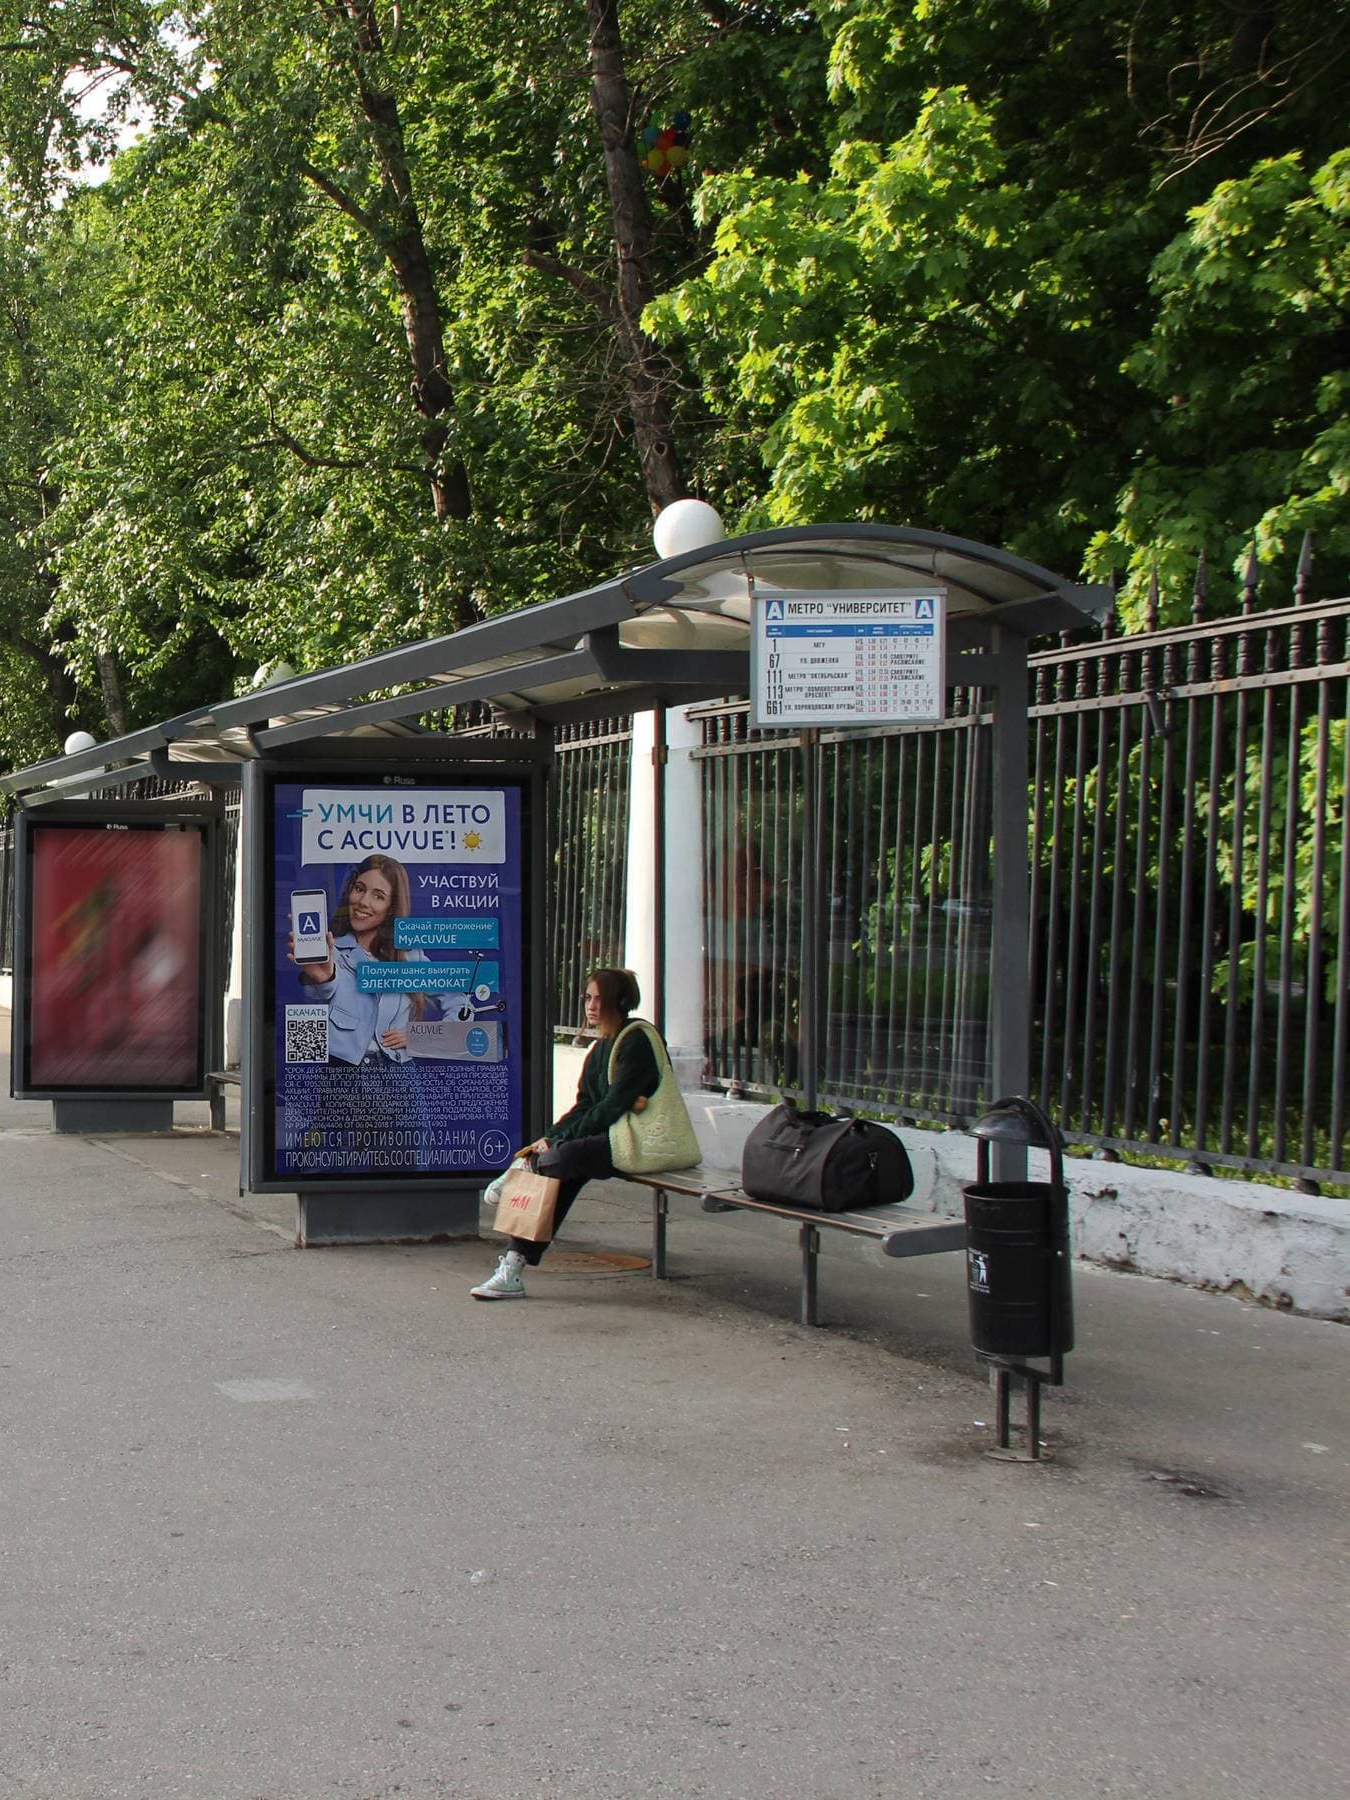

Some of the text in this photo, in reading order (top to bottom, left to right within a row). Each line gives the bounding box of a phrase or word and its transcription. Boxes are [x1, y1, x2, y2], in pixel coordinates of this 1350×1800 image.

[788, 603, 824, 614] МЕТРО
[771, 639, 778, 652] 1
[769, 653, 781, 668] 67
[767, 670, 782, 683] 111
[767, 685, 784, 699] 113
[766, 700, 783, 715] 661
[318, 803, 491, 824] УМЧИ В ЛЕТО
[317, 829, 334, 850] С
[418, 872, 499, 889] УЧАСТВУЙ
[431, 895, 499, 910] В АКЦИИ
[398, 920, 432, 931] Скачай
[398, 934, 458, 946] MyACUVUE
[361, 965, 471, 978] Получи шанс выиграть
[286, 1007, 328, 1017] СКАЧАТЬ
[410, 1024, 443, 1036] ACUVUE
[285, 1130, 476, 1148] ИМЕЮТСЯ ПРОТИВОПОКАЗАНИЯ
[484, 1137, 504, 1157] 6+
[285, 1148, 476, 1168] ПРОКОНСУЛЬТИРУЙТЕСЬ СО СПЕЦИАЛИСТОМ
